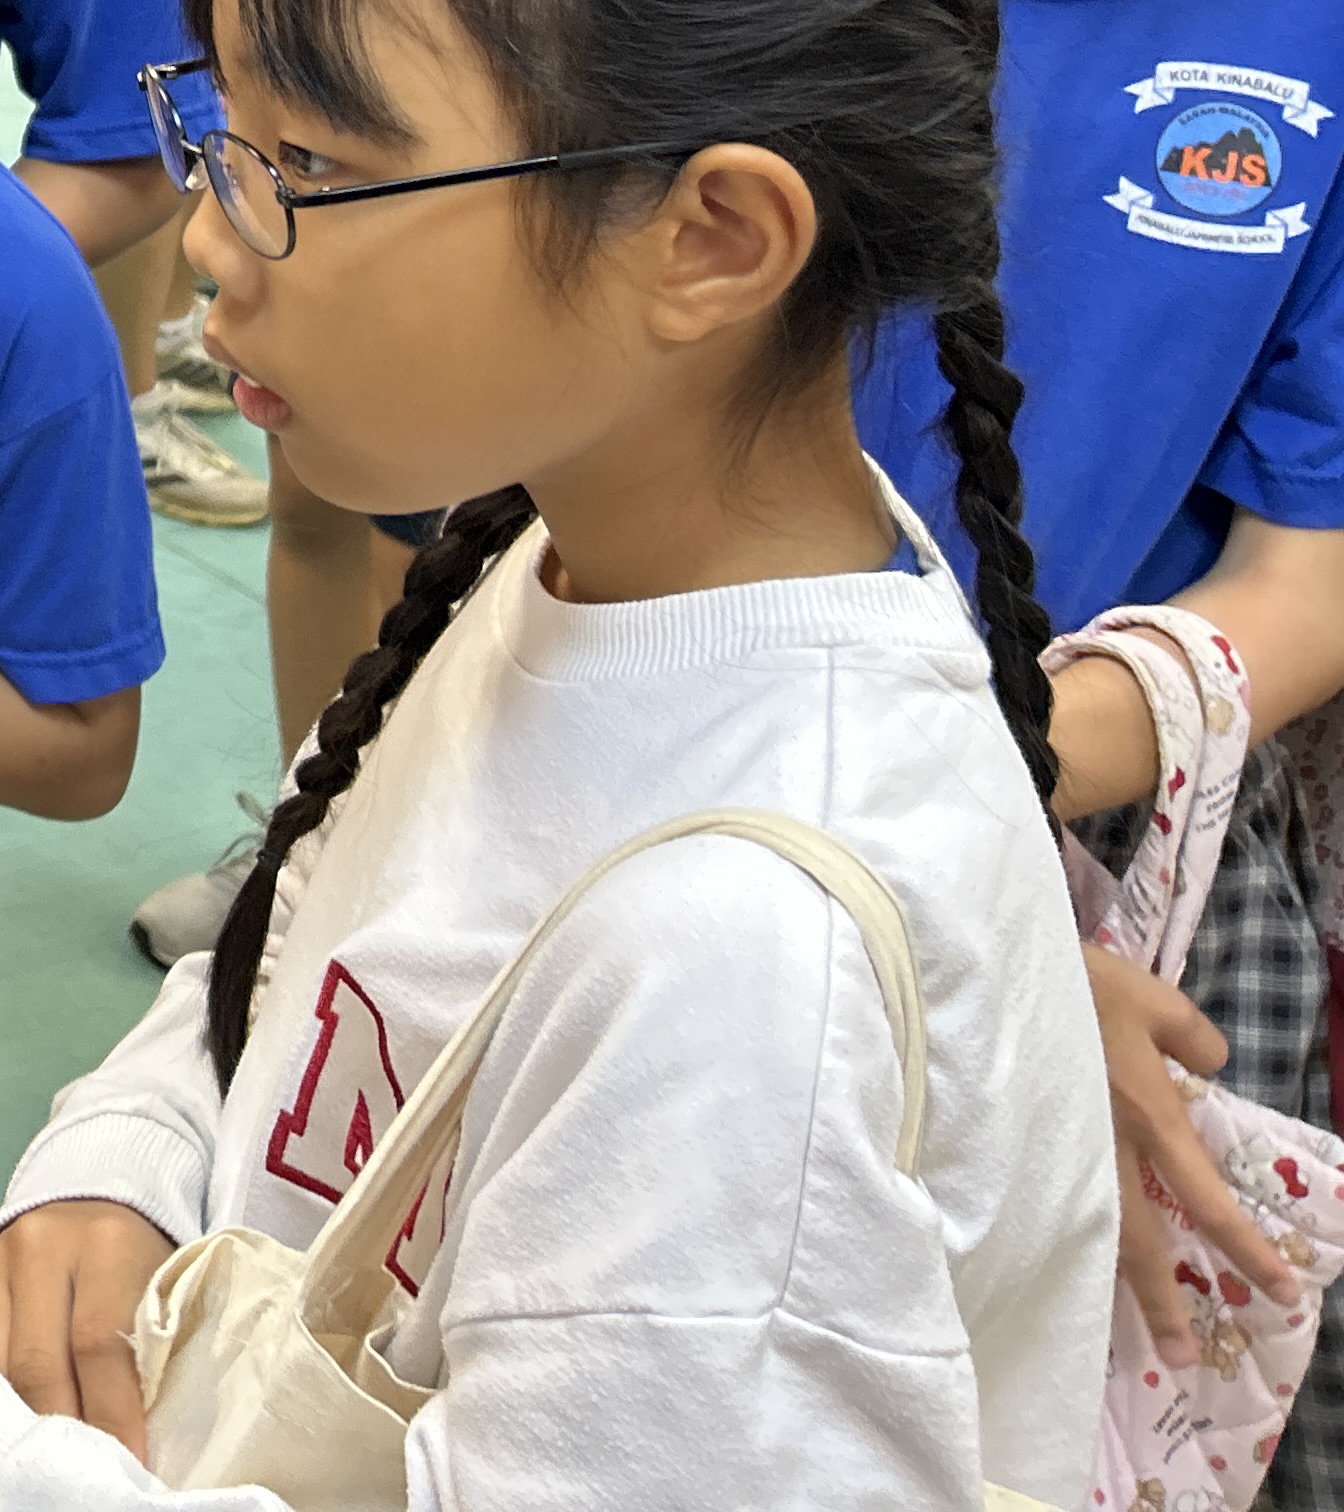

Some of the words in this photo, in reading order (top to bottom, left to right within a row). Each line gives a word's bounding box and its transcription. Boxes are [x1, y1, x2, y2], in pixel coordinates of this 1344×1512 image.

[1169, 69, 1209, 83] KOTA
[1216, 72, 1294, 100] KINABALU
[1179, 145, 1267, 188] KJS
